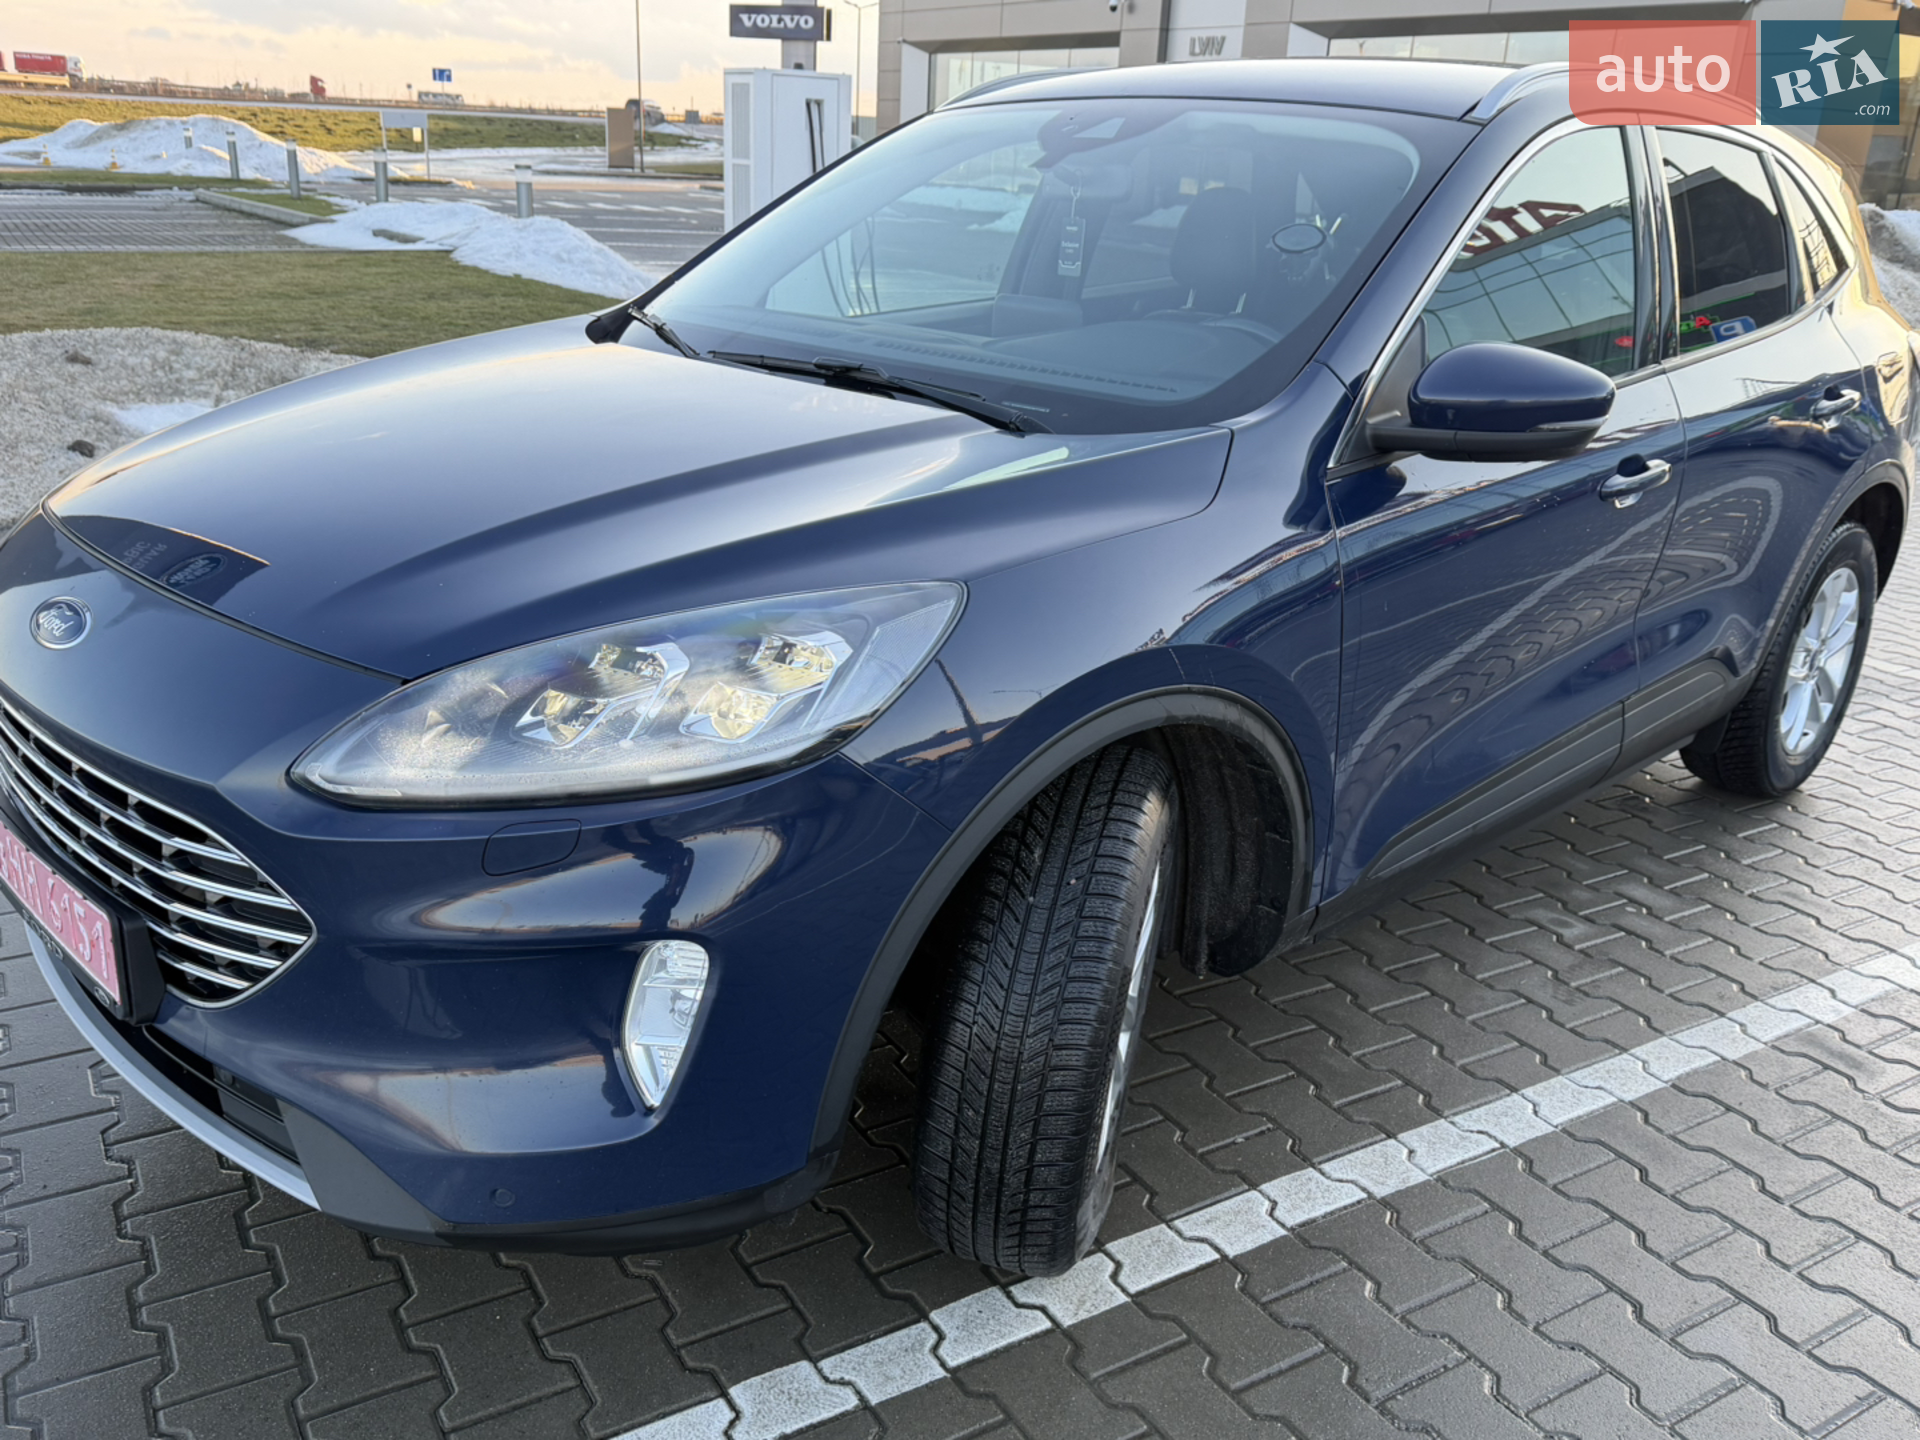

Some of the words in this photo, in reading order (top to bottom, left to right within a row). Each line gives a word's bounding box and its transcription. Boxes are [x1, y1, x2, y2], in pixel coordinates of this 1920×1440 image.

[738, 13, 815, 29] VOLVO
[1188, 35, 1227, 56] LVIV
[38, 603, 74, 637] Ford
[22, 909, 64, 960] FORD
